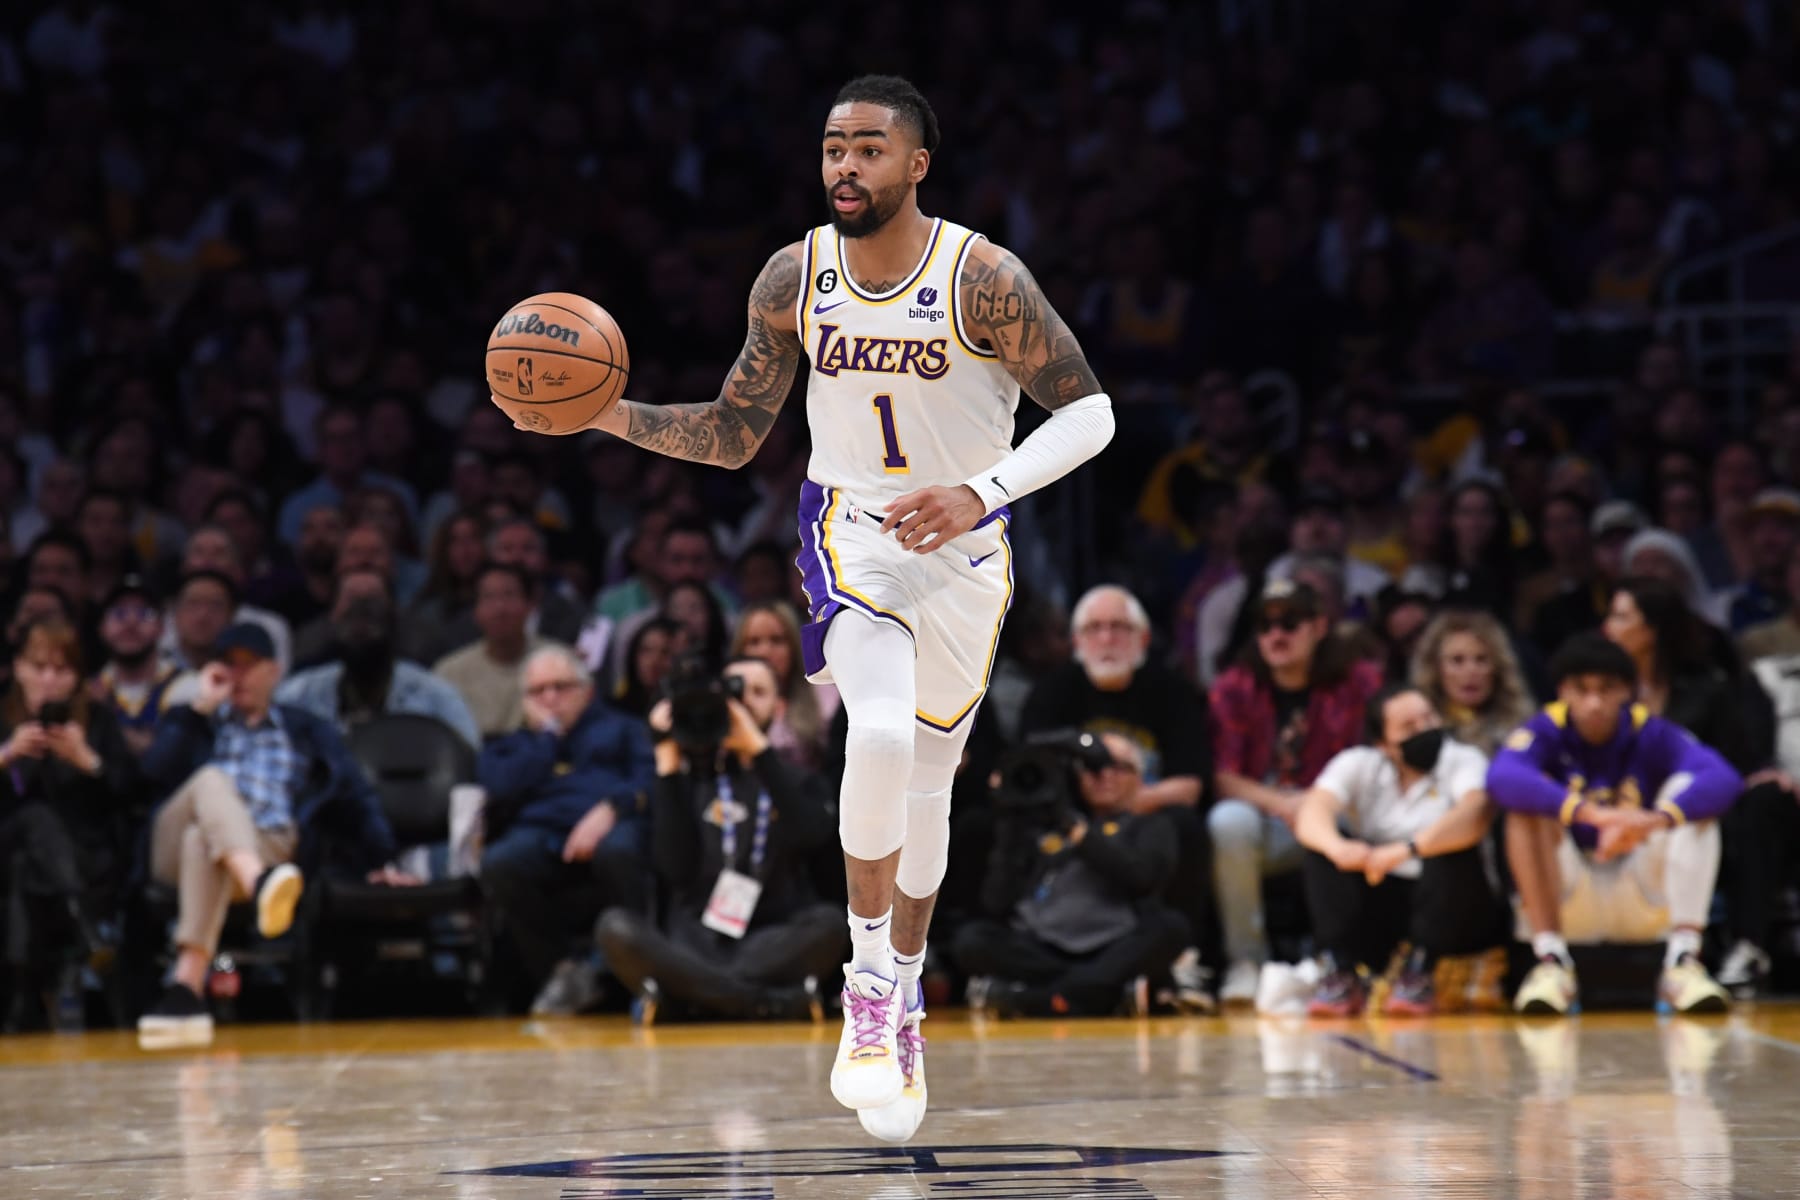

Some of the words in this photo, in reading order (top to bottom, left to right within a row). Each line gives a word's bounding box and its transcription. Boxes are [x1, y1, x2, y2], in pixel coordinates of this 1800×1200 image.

[820, 271, 835, 292] 6
[497, 313, 579, 347] Wilson
[909, 308, 944, 322] bibigo
[815, 323, 950, 380] LAKERS
[871, 393, 911, 475] 1
